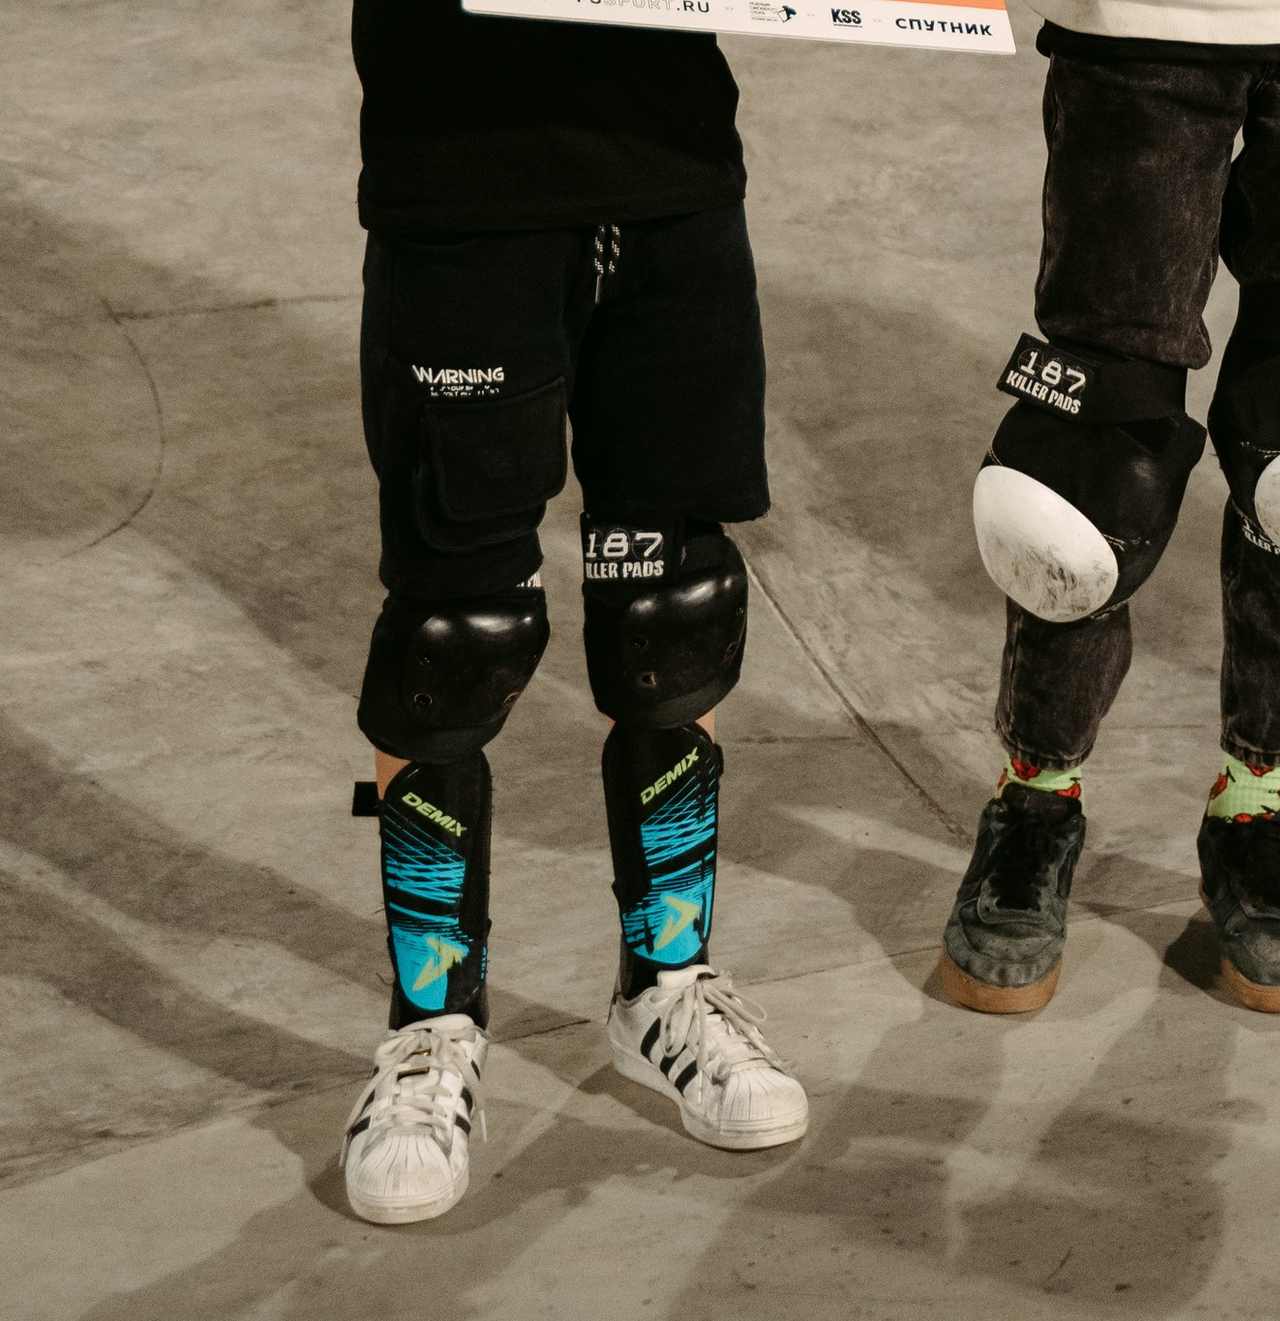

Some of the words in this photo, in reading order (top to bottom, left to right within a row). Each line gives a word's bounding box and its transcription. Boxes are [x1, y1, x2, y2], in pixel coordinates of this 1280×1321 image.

[830, 8, 863, 25] KSS
[895, 18, 993, 37] СПУТНИК
[412, 364, 505, 384] WARNING
[1020, 351, 1086, 393] 187
[1006, 370, 1049, 401] KILLER
[1047, 389, 1081, 414] PADS
[585, 532, 664, 558] 187
[622, 560, 665, 578] PADS
[639, 746, 700, 805] DEMIX
[401, 791, 468, 837] DEMIX
